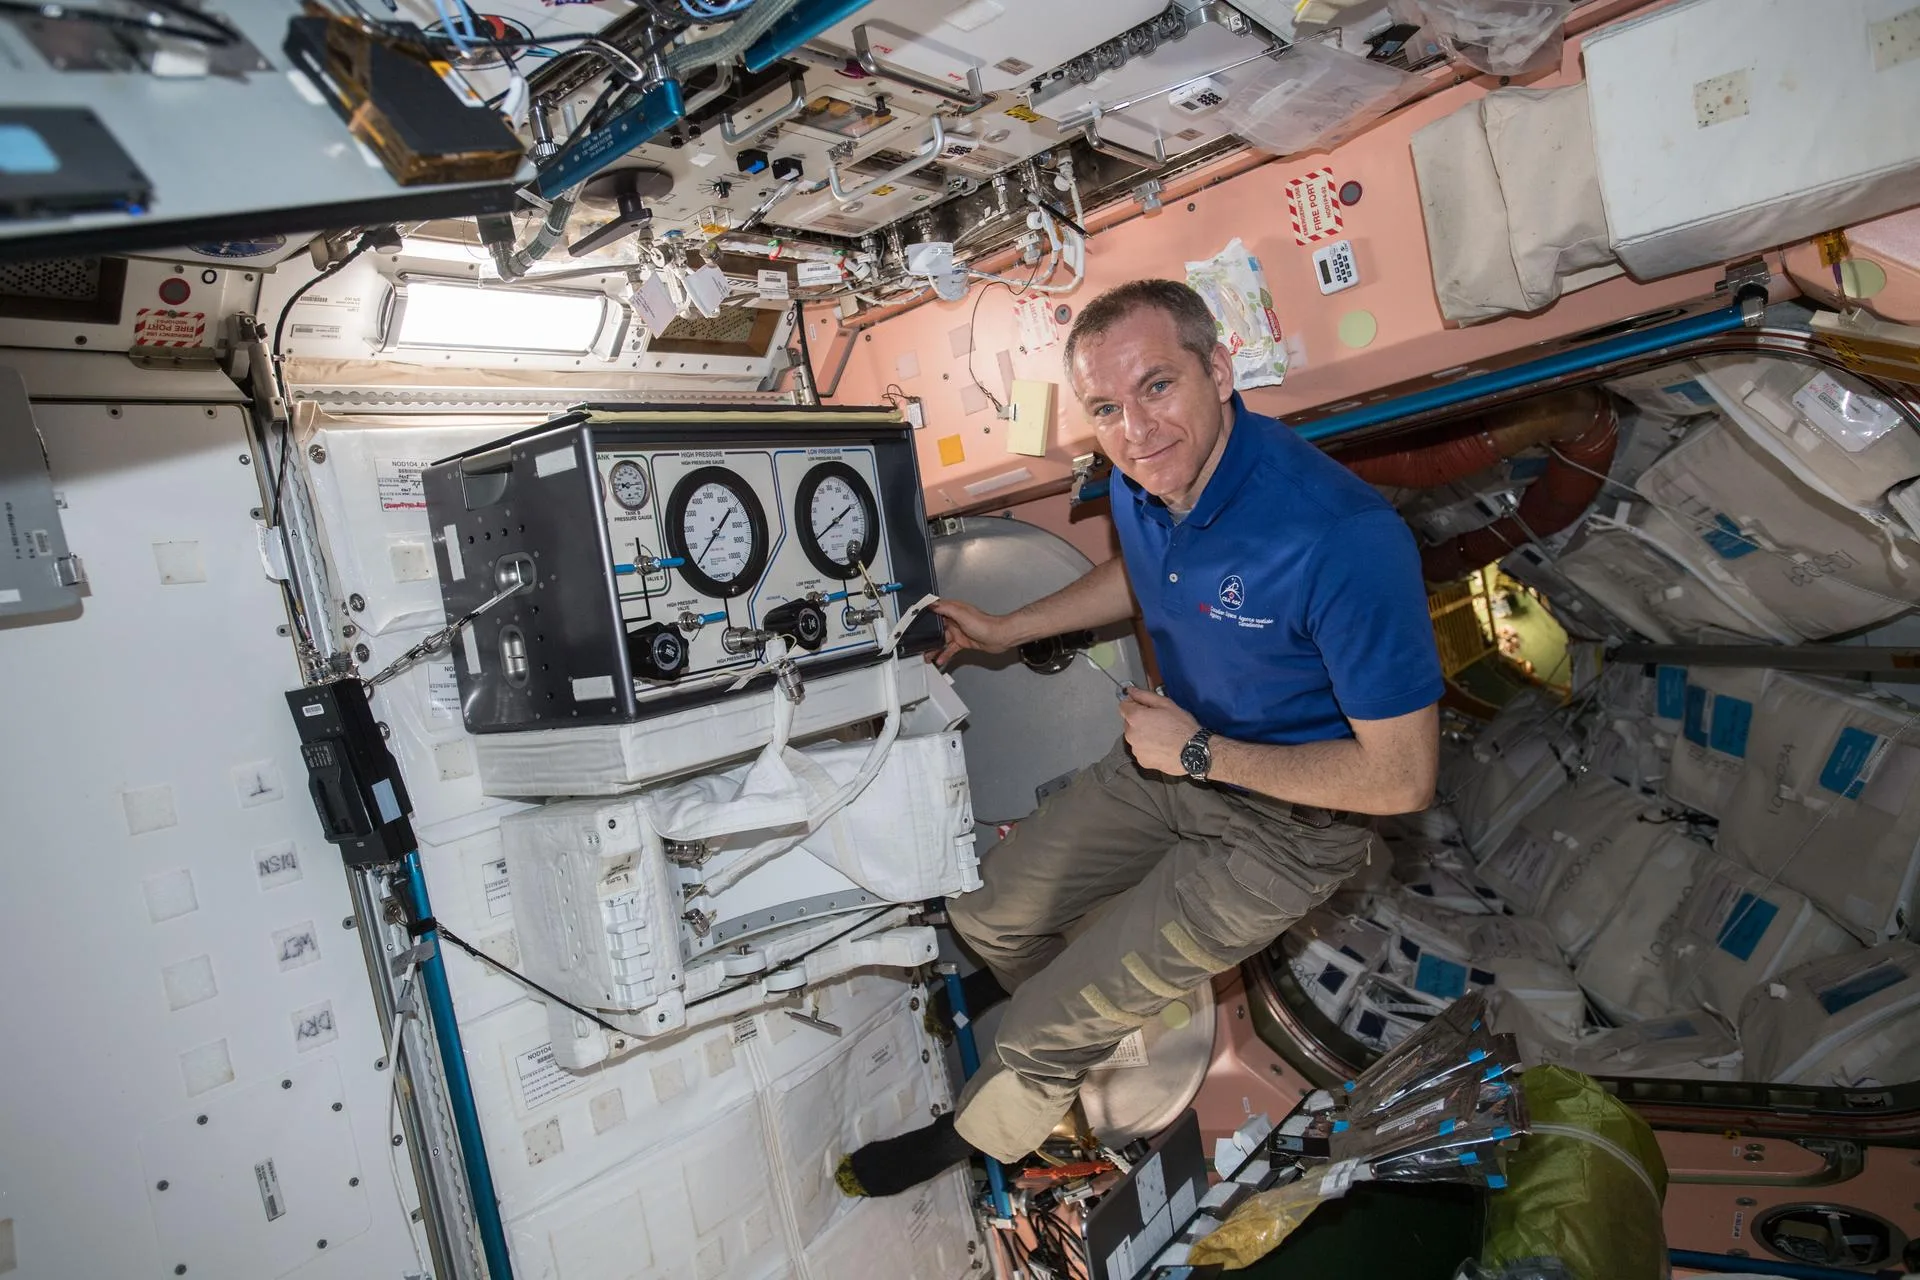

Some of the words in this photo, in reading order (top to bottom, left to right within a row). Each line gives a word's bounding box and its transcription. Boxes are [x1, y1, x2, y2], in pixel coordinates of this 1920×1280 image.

[1306, 184, 1318, 208] PORT
[1312, 208, 1322, 231] FIRE
[297, 1010, 332, 1040] DRY
